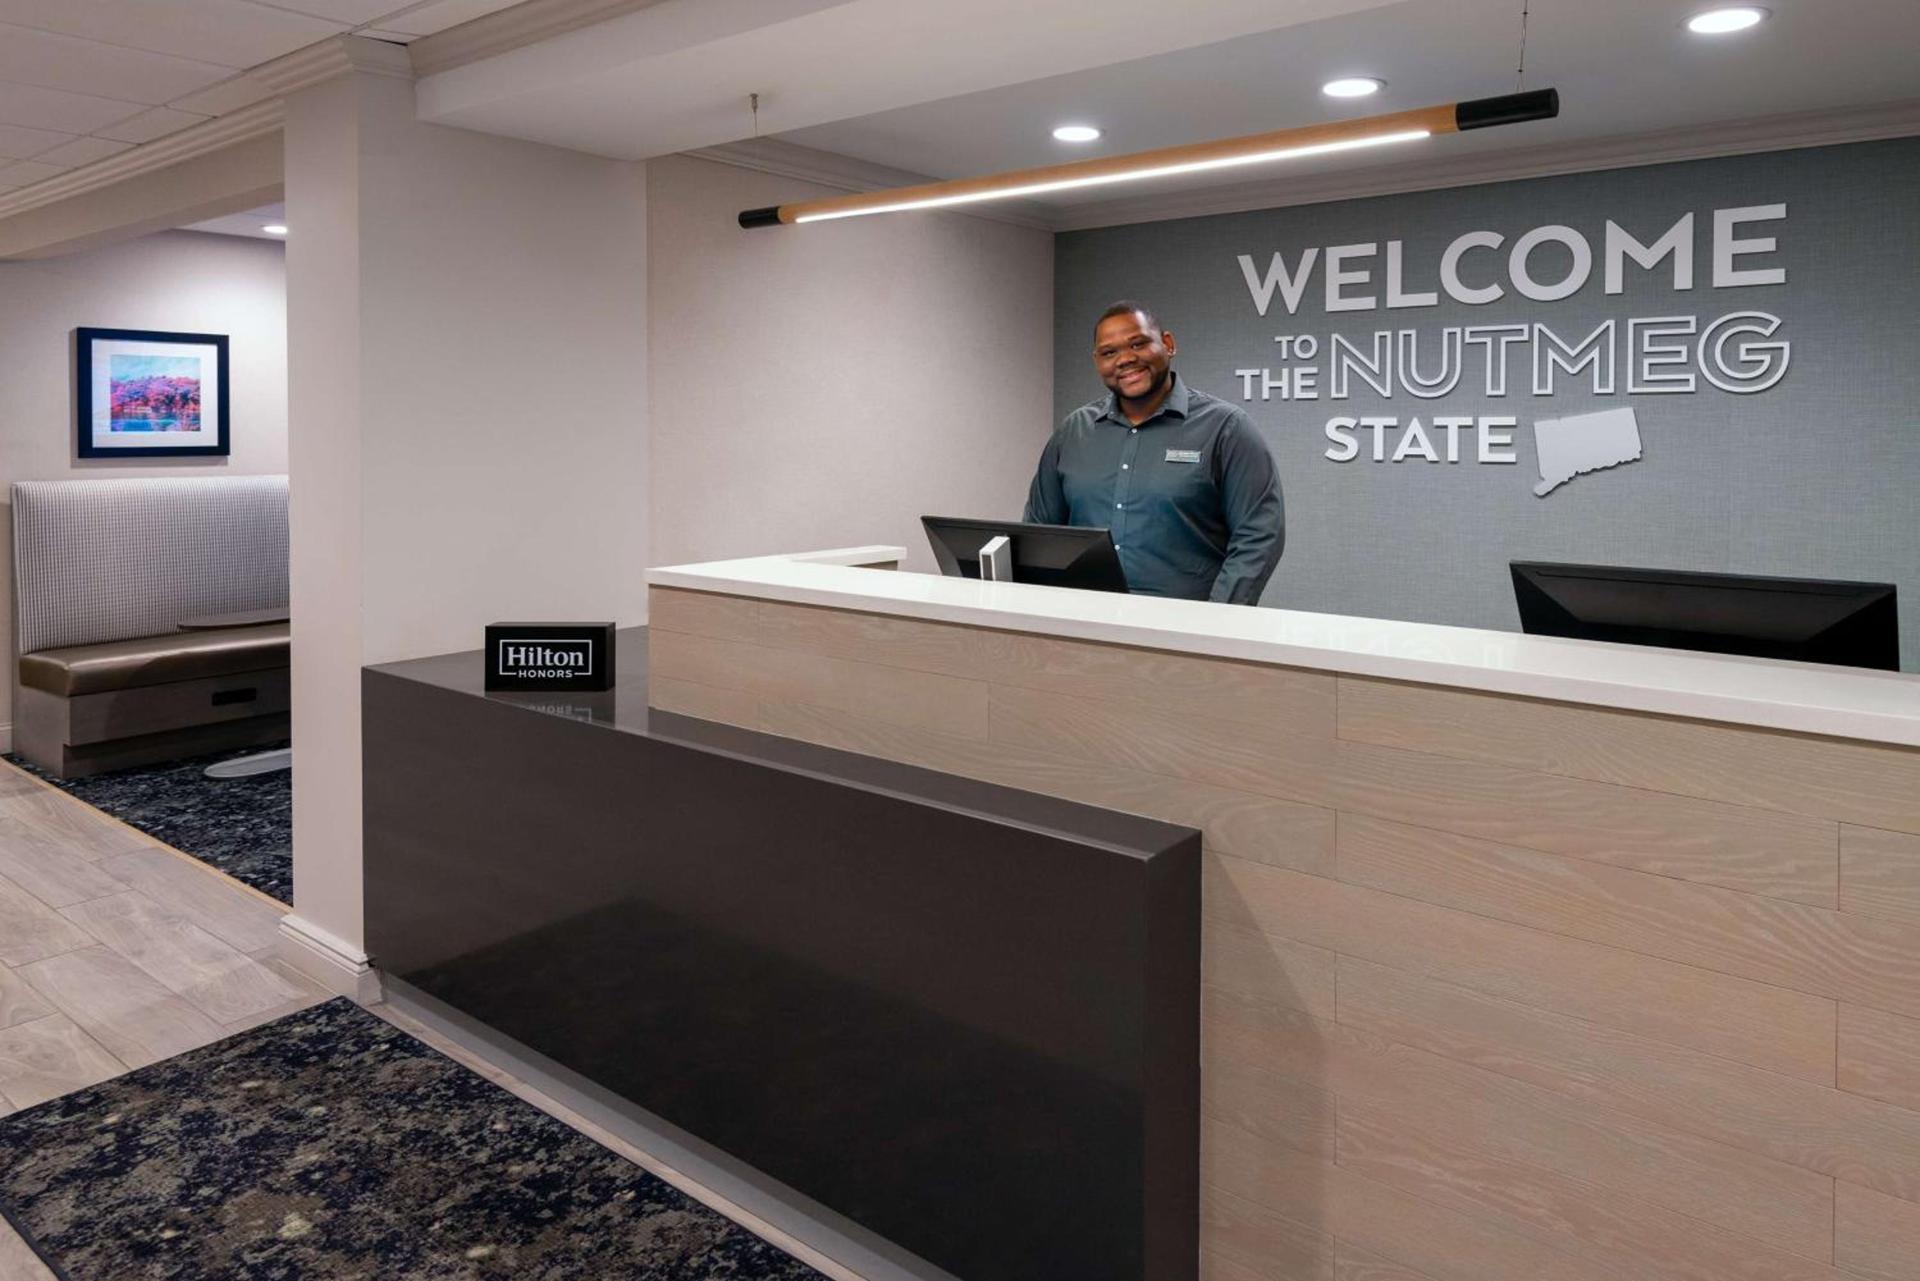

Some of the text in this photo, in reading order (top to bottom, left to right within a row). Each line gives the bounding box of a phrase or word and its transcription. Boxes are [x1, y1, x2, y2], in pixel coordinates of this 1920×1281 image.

[1237, 203, 1787, 317] WELCOME
[1235, 310, 1791, 401] THE NUTMEG
[1275, 334, 1318, 361] TO
[1323, 415, 1517, 463] STATE
[507, 646, 585, 667] Hilton
[518, 669, 574, 679] HONORS
